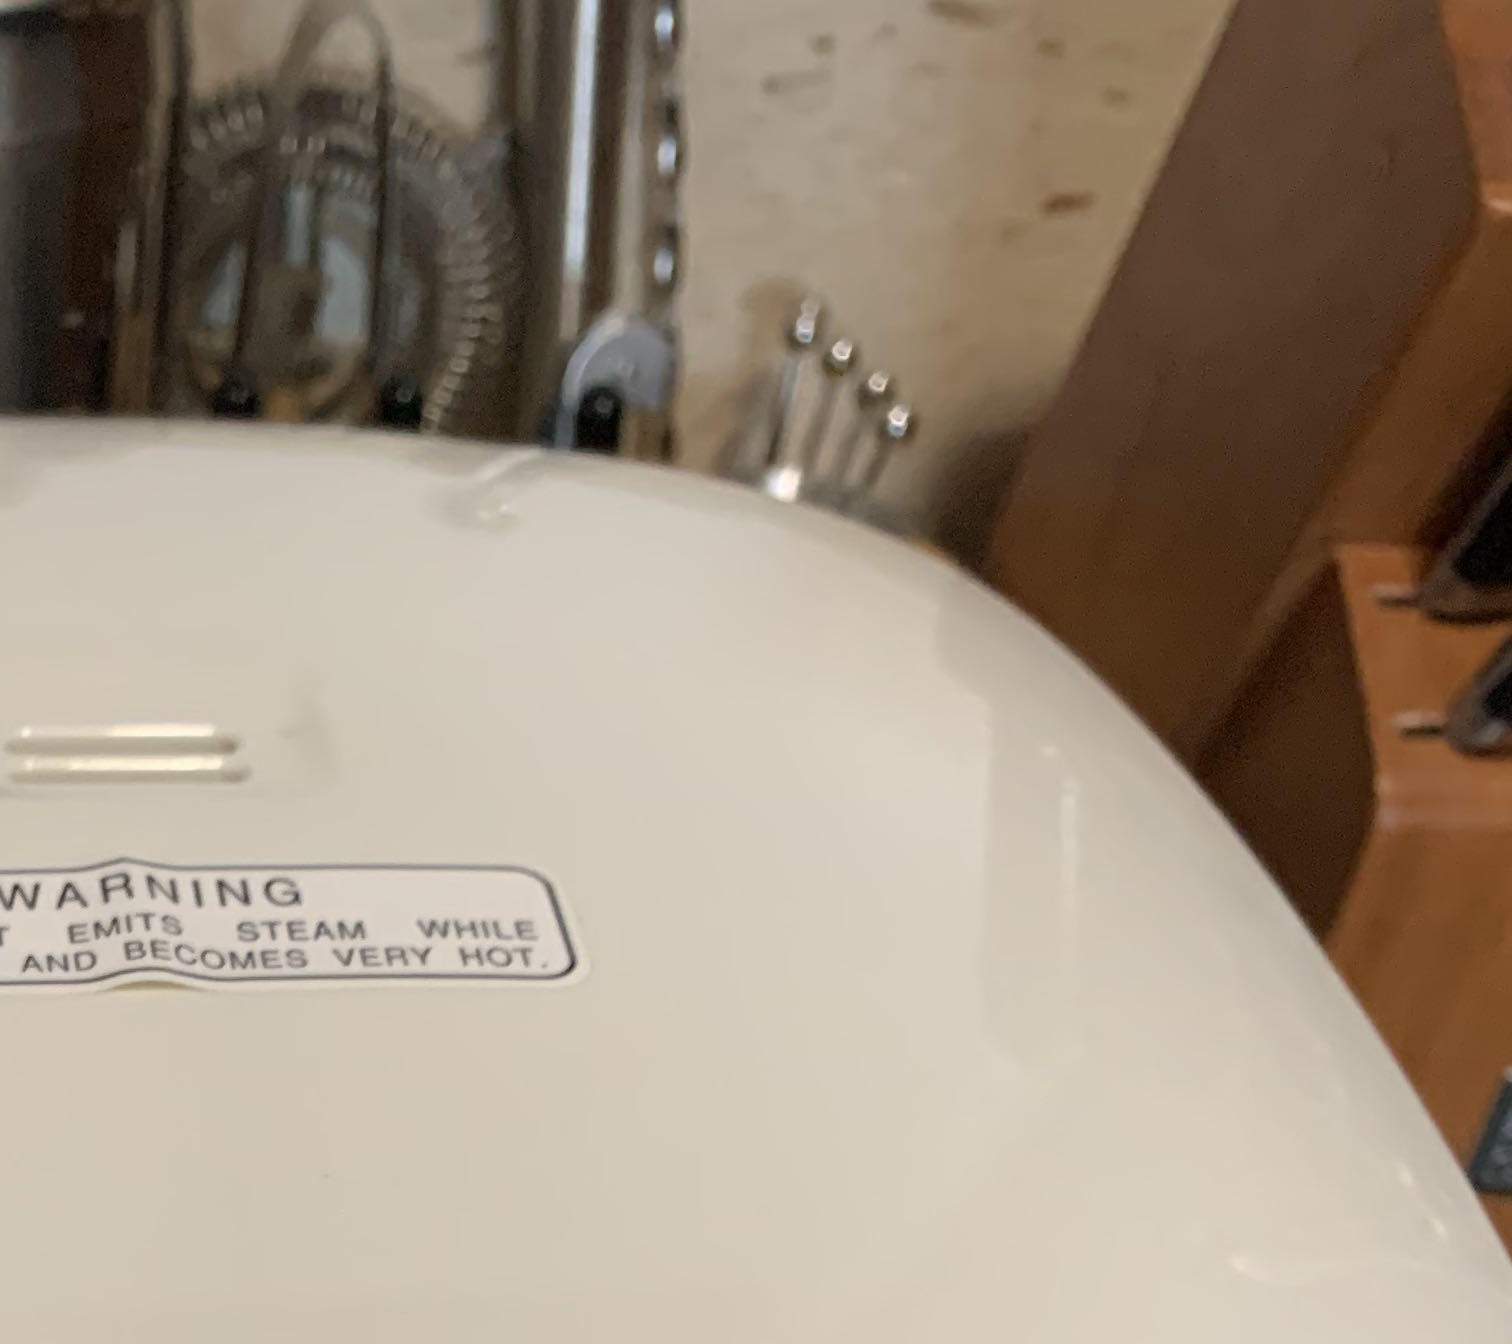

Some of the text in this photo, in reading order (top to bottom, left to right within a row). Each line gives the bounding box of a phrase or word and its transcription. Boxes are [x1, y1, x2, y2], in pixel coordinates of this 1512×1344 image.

[67, 911, 183, 944] EMITS
[237, 919, 367, 943] STEAM
[418, 918, 539, 942] WHILE
[21, 949, 98, 974] AND
[123, 941, 308, 970] BECOMES
[332, 946, 432, 971] VERY
[460, 945, 549, 971] HOT.
